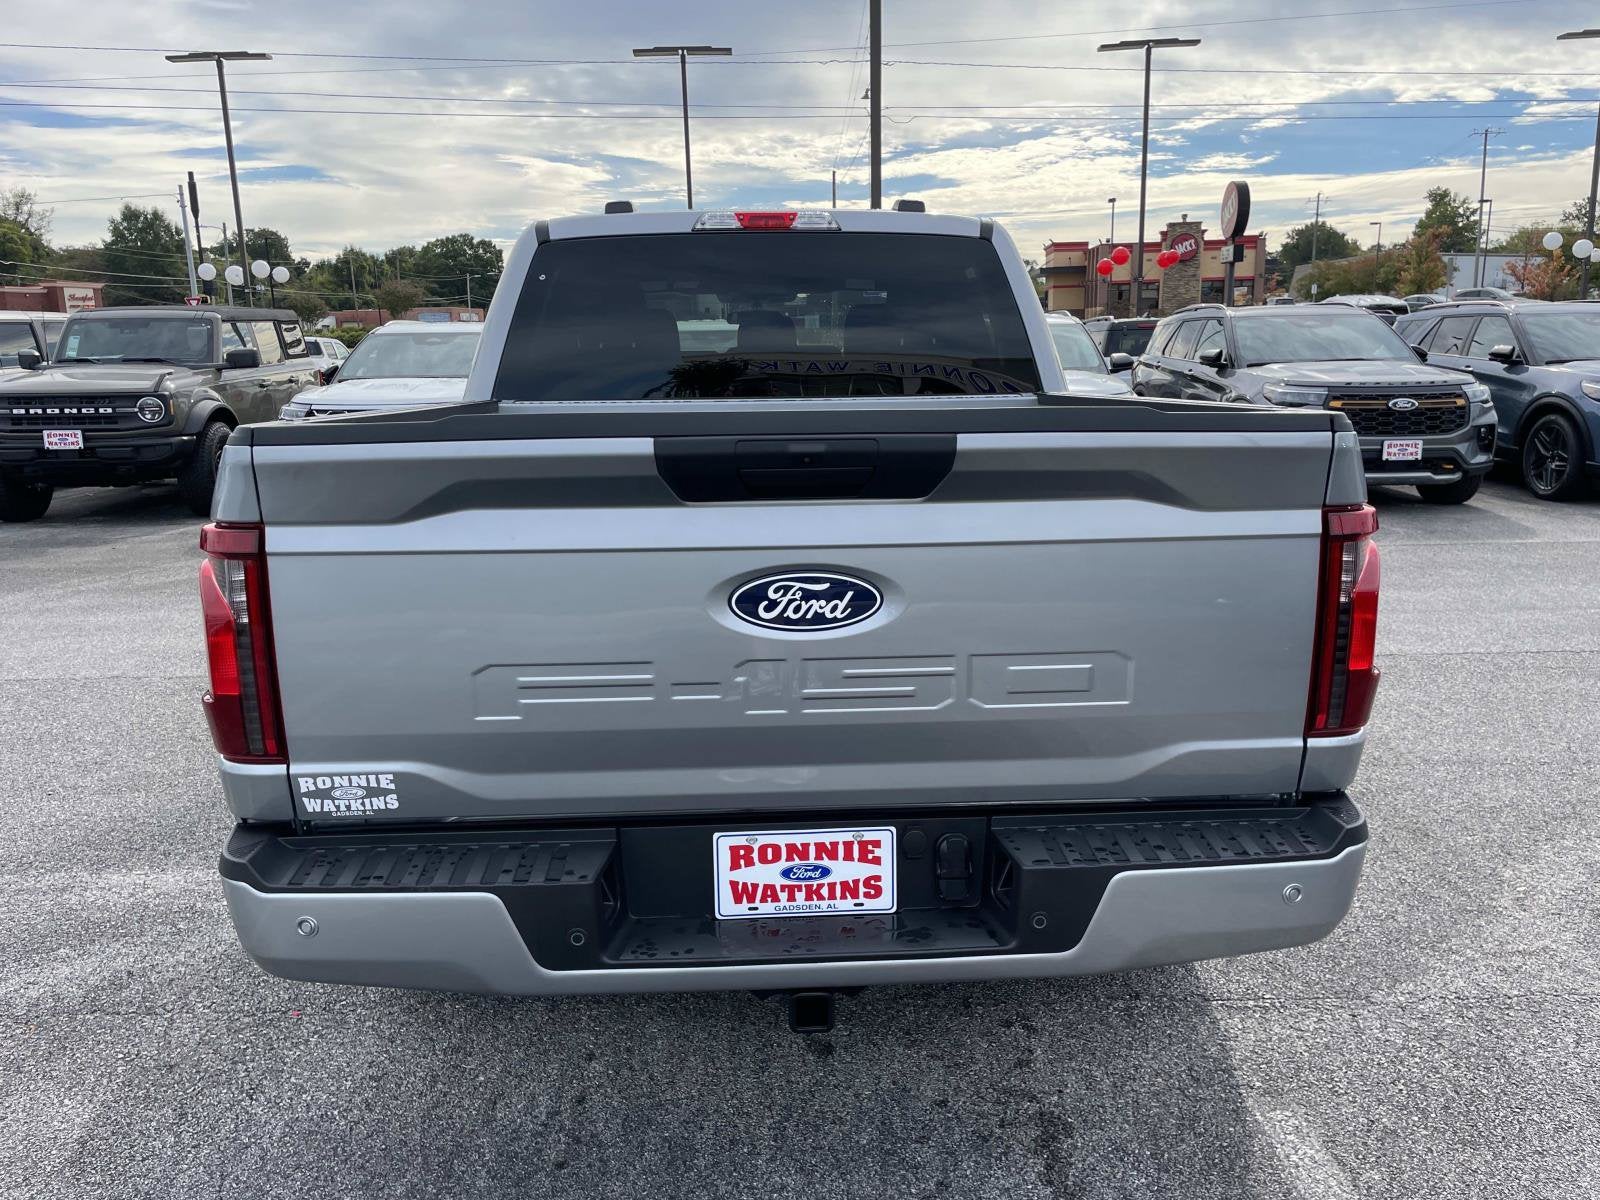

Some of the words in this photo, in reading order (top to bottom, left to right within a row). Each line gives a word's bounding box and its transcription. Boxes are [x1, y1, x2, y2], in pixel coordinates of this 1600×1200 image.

[47, 431, 79, 439] RONNIE
[758, 581, 854, 619] Ford
[471, 650, 1134, 721] F-150
[298, 774, 395, 793] RONNIE
[302, 794, 399, 812] WATKINS
[729, 840, 882, 871] RONNIE
[789, 865, 823, 879] Ford
[729, 874, 883, 904] WATKINS
[774, 903, 824, 911] GADSDEN,
